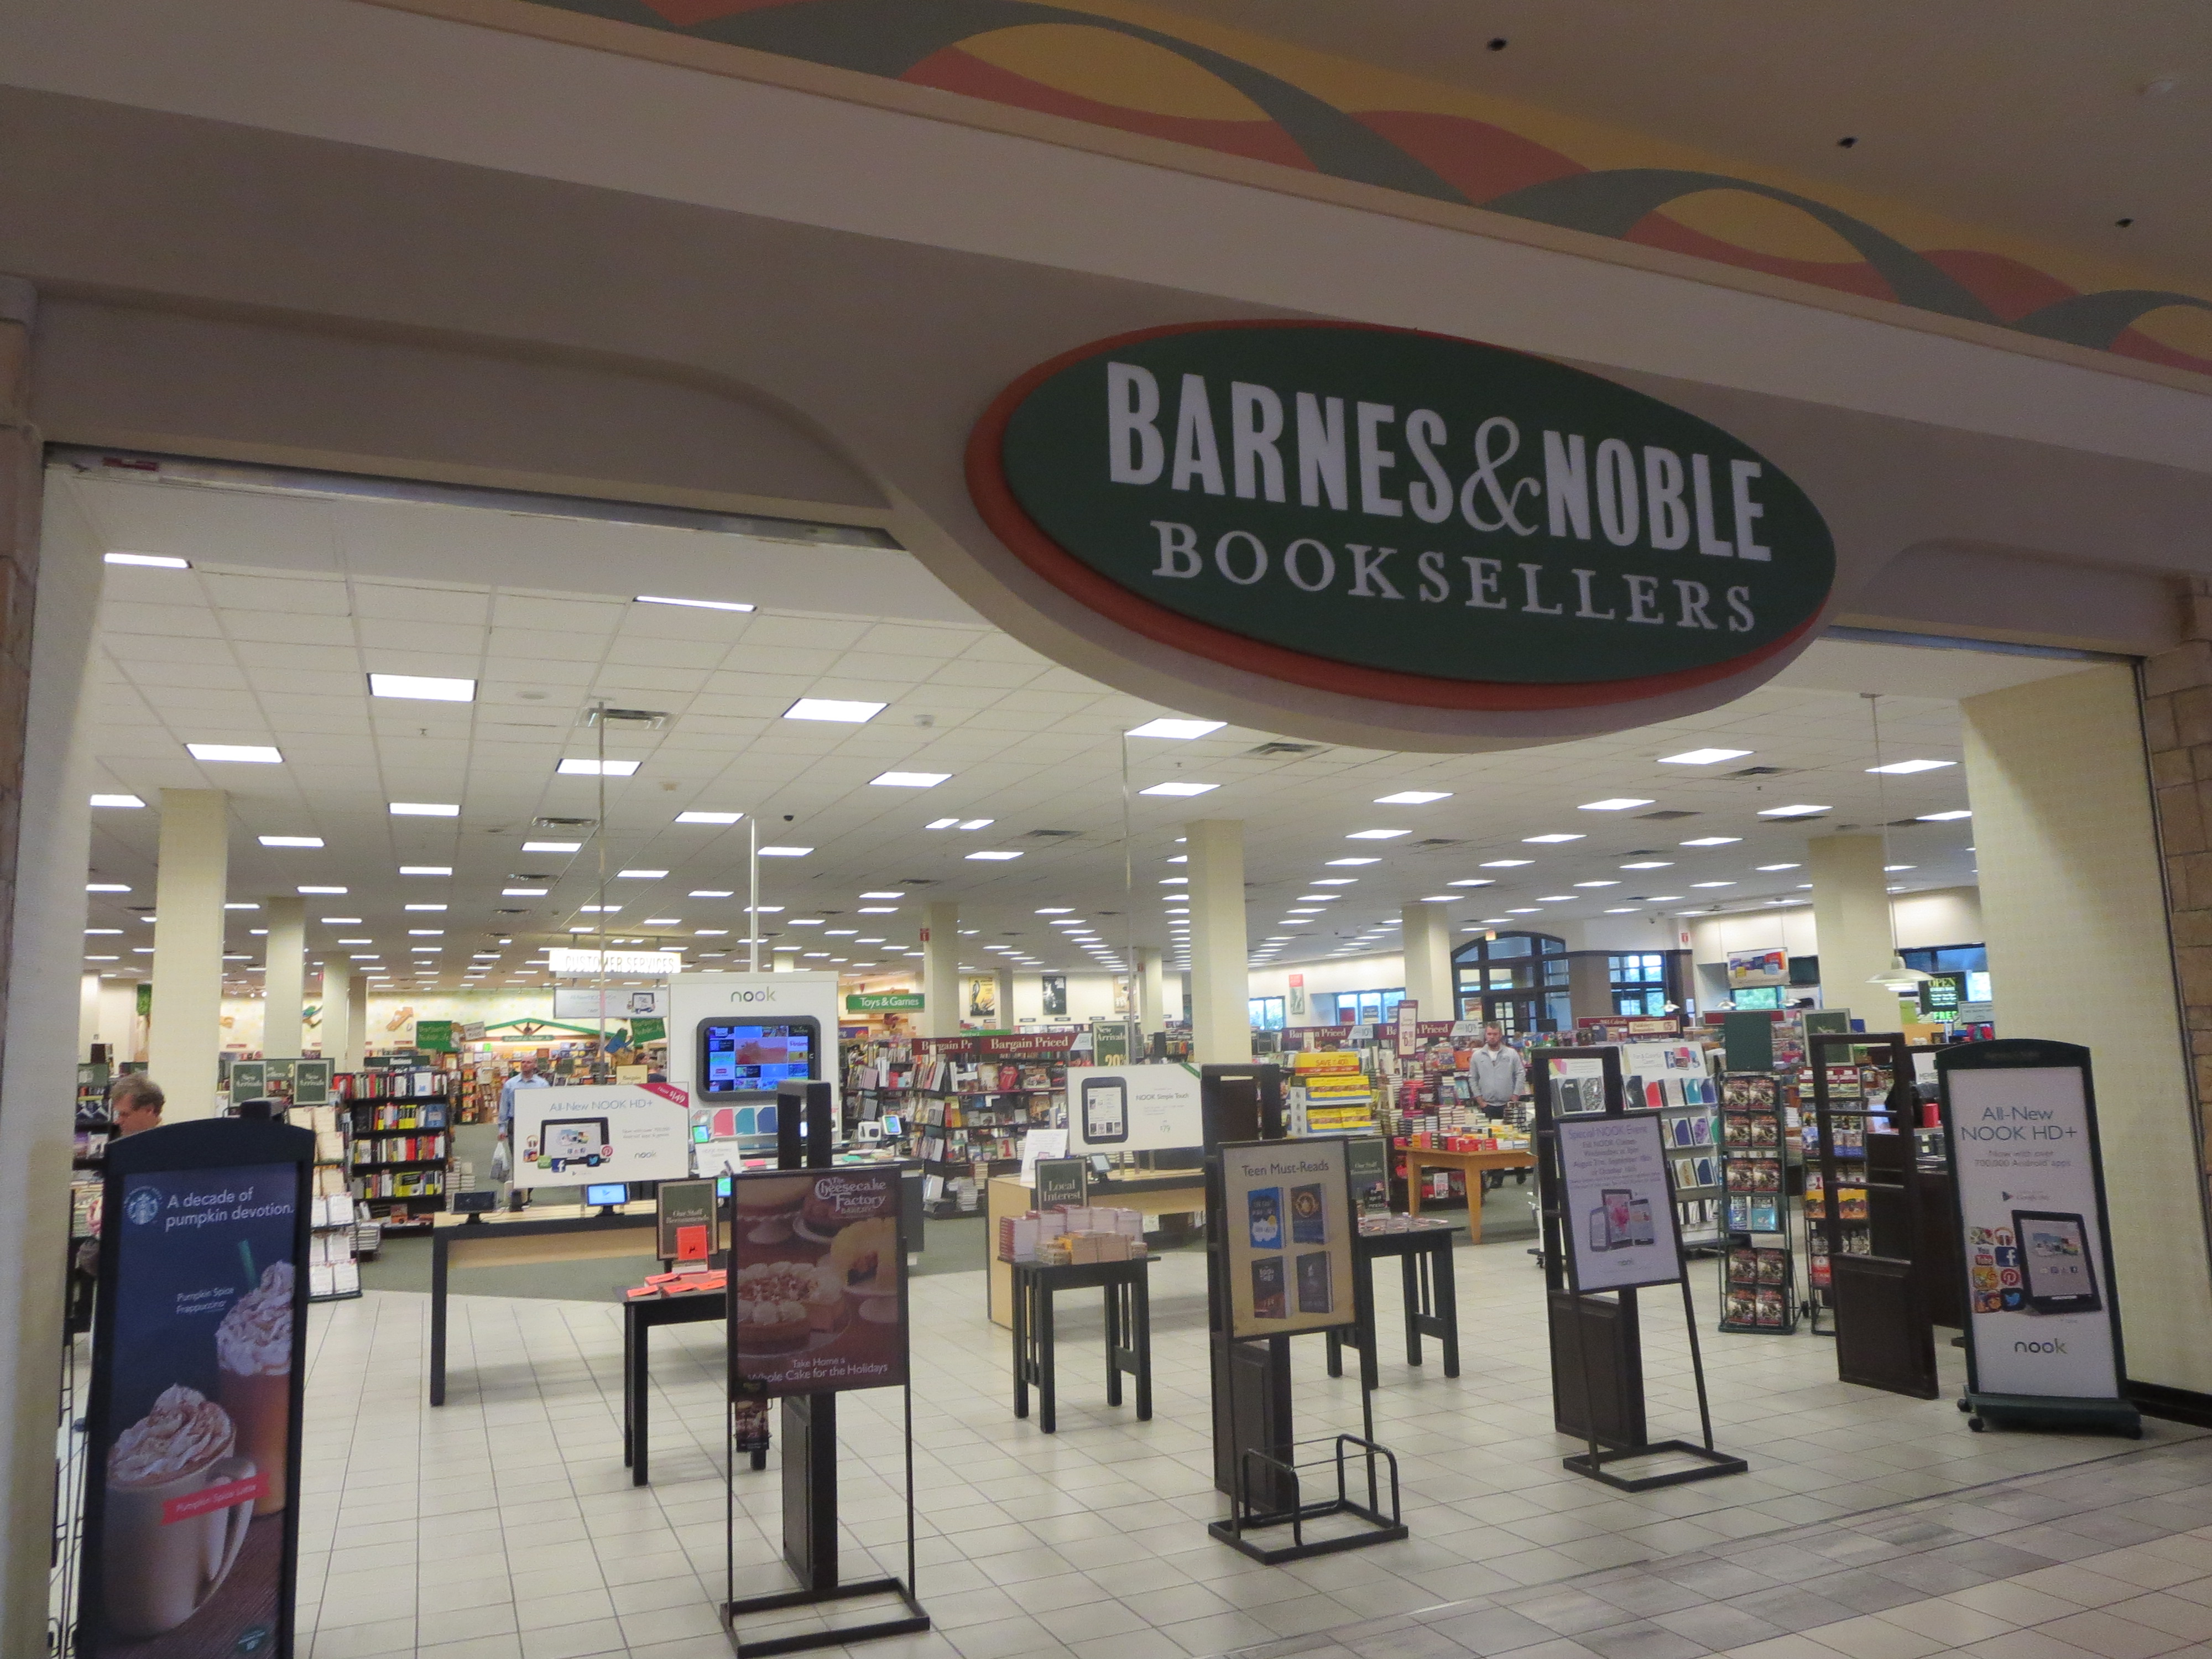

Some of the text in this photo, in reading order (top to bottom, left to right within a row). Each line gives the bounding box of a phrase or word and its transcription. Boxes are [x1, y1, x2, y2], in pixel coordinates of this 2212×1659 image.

[1150, 518, 1756, 633] BOOKSELLERS
[626, 957, 675, 973] SERVICES
[730, 986, 776, 1003] nook
[859, 997, 880, 1009] Toys
[889, 997, 920, 1006] Games
[1321, 1027, 1346, 1038] Priced
[1421, 1024, 1448, 1034] Priced
[921, 1040, 959, 1053] Bgain
[990, 1036, 1068, 1052] Bargain Priced
[668, 1088, 686, 1104] $149
[549, 1098, 654, 1113] All-New NOOK HD+
[1981, 1107, 2054, 1121] All-New
[1961, 1125, 2078, 1141] NOOK HD+
[634, 1150, 657, 1159] nook
[1241, 1159, 1329, 1177] Teen Must-Reads
[815, 1177, 887, 1200] Cheesecake
[1048, 1179, 1076, 1191] Local
[166, 1194, 180, 1209] A
[182, 1189, 236, 1208] decade
[238, 1186, 254, 1202] of
[833, 1191, 886, 1212] Factory
[1043, 1191, 1082, 1202] Interest
[165, 1202, 295, 1233] pumpkin devotion.
[2014, 1338, 2068, 1354] nook
[793, 1359, 811, 1369] Take
[812, 1358, 839, 1366] Home
[785, 1369, 811, 1381] Cake
[813, 1368, 827, 1378] for
[830, 1366, 846, 1377] the
[847, 1363, 888, 1376] Holidays
